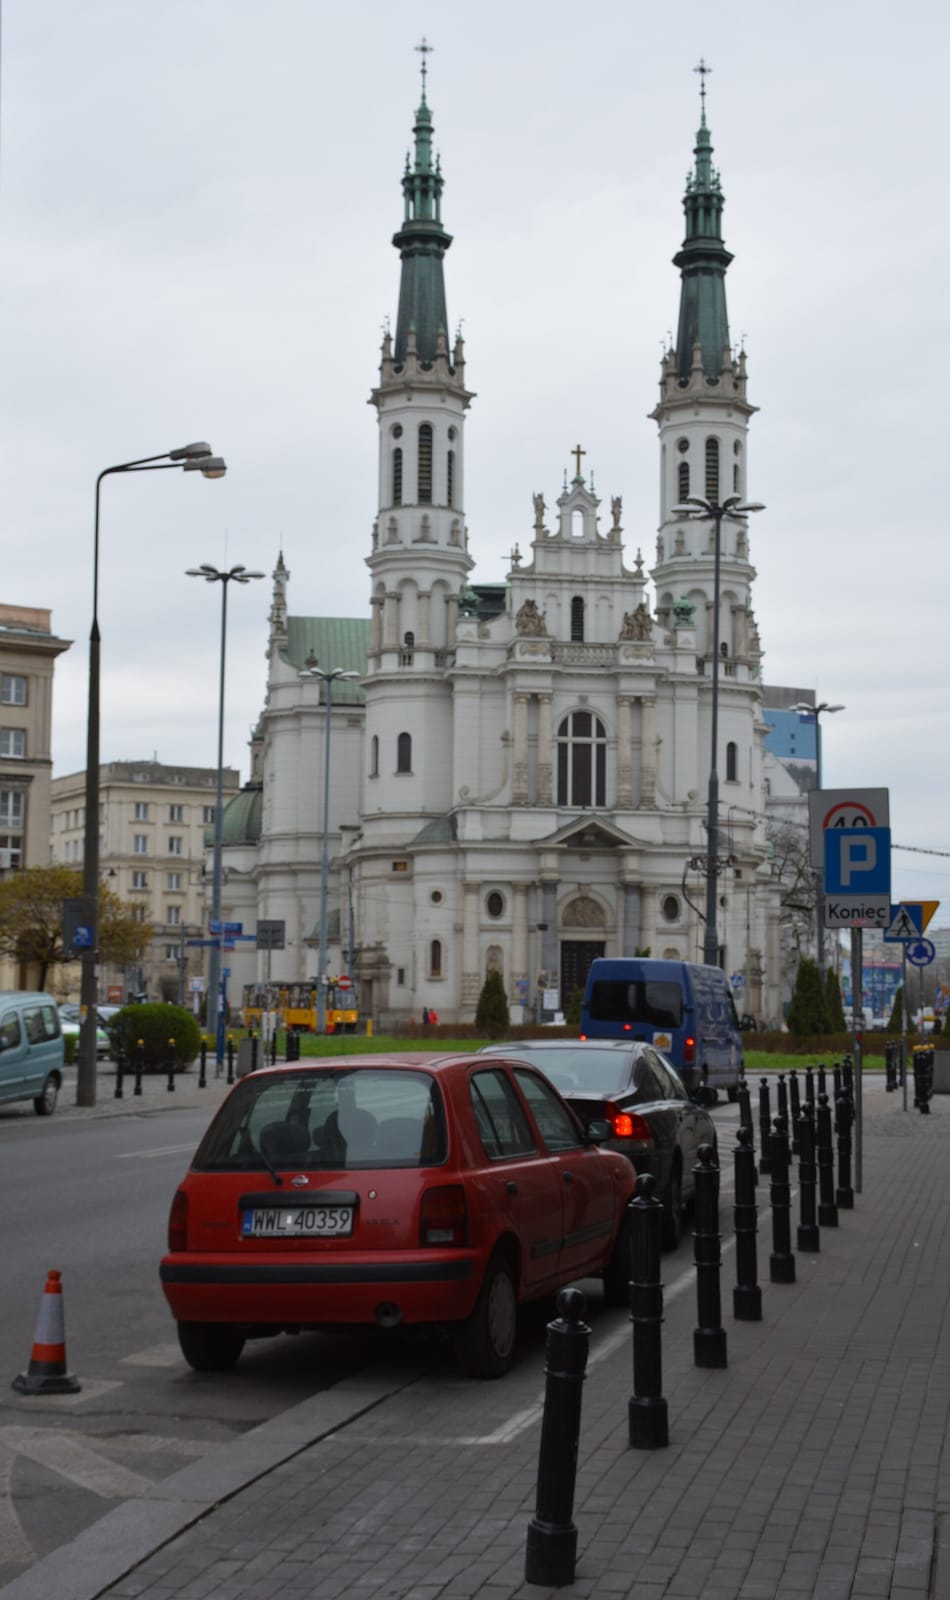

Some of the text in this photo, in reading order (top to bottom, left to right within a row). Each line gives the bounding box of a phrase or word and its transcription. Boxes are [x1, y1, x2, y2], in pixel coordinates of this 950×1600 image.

[840, 834, 876, 886] P
[828, 904, 886, 919] Koniec
[254, 1209, 286, 1231] WWL
[294, 1209, 350, 1230] 40359
